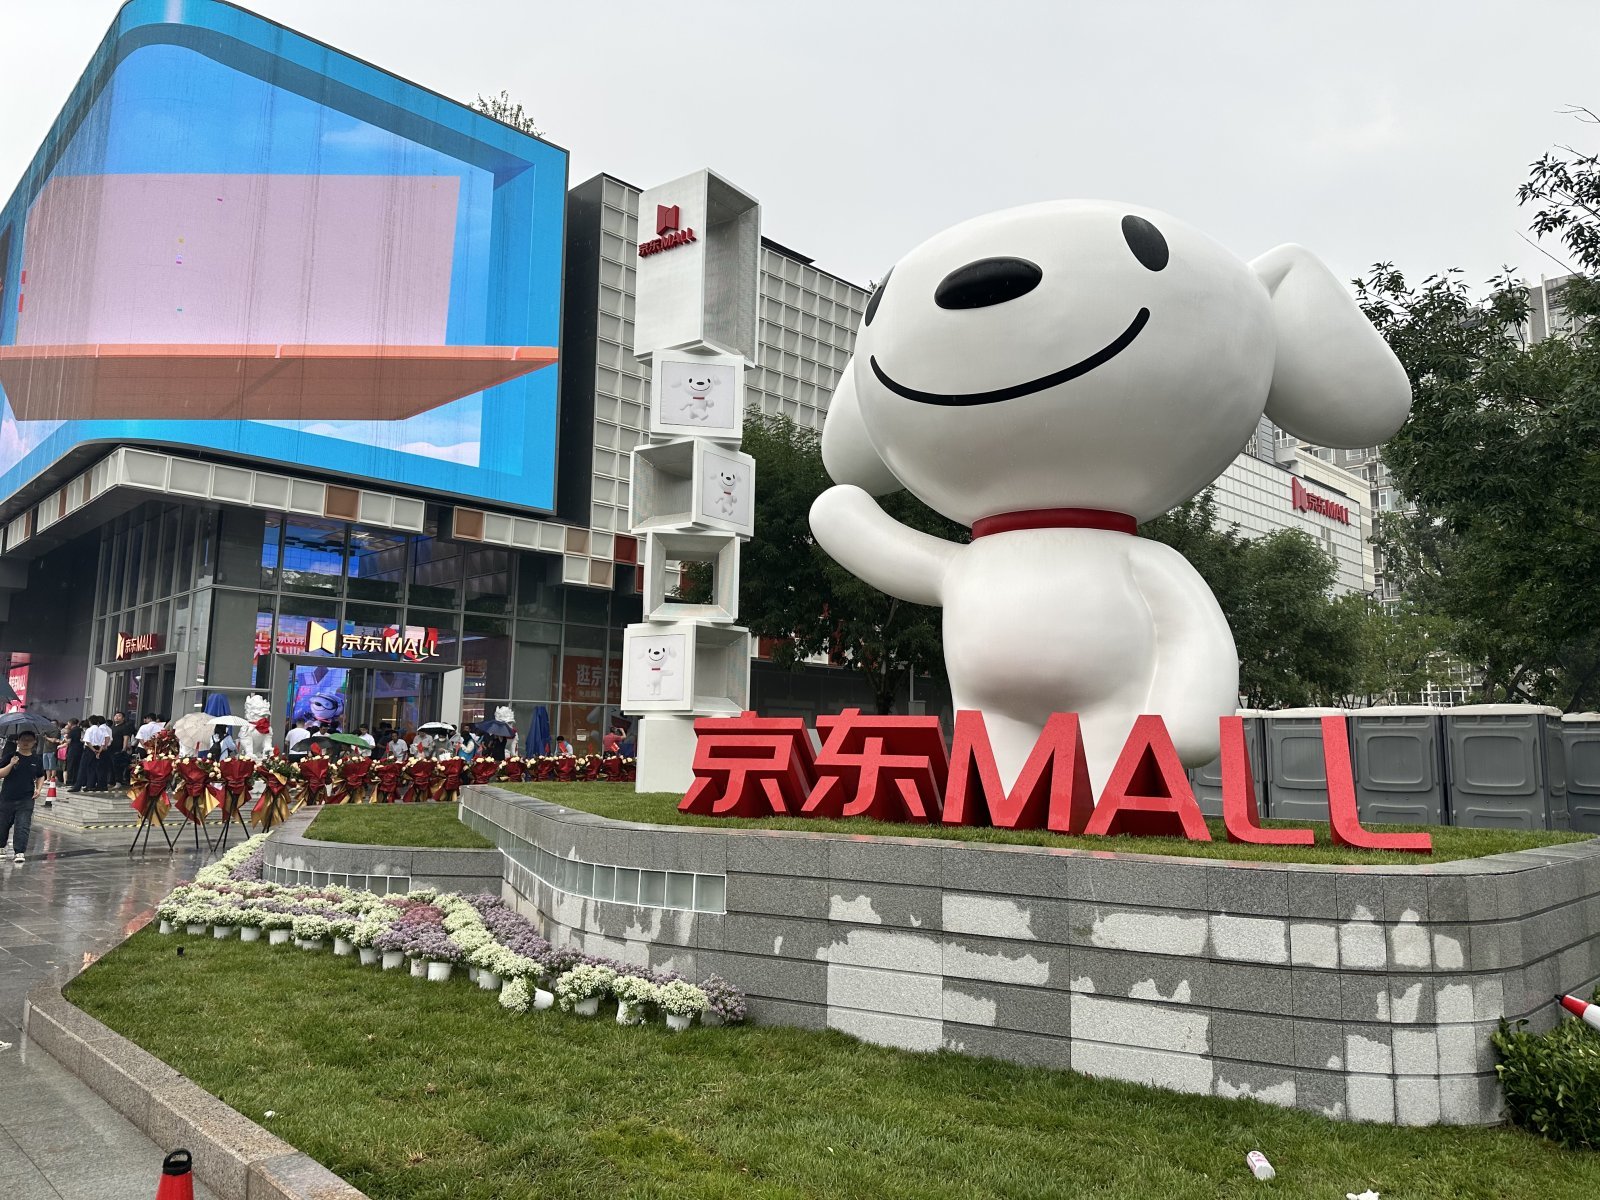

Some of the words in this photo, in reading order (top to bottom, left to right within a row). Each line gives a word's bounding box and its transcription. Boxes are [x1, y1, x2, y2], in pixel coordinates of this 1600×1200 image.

[638, 227, 696, 257] 京东MALL
[125, 633, 152, 653] 京东MALL
[342, 634, 440, 657] 京东MALL
[677, 708, 1432, 855] 京东MALL
